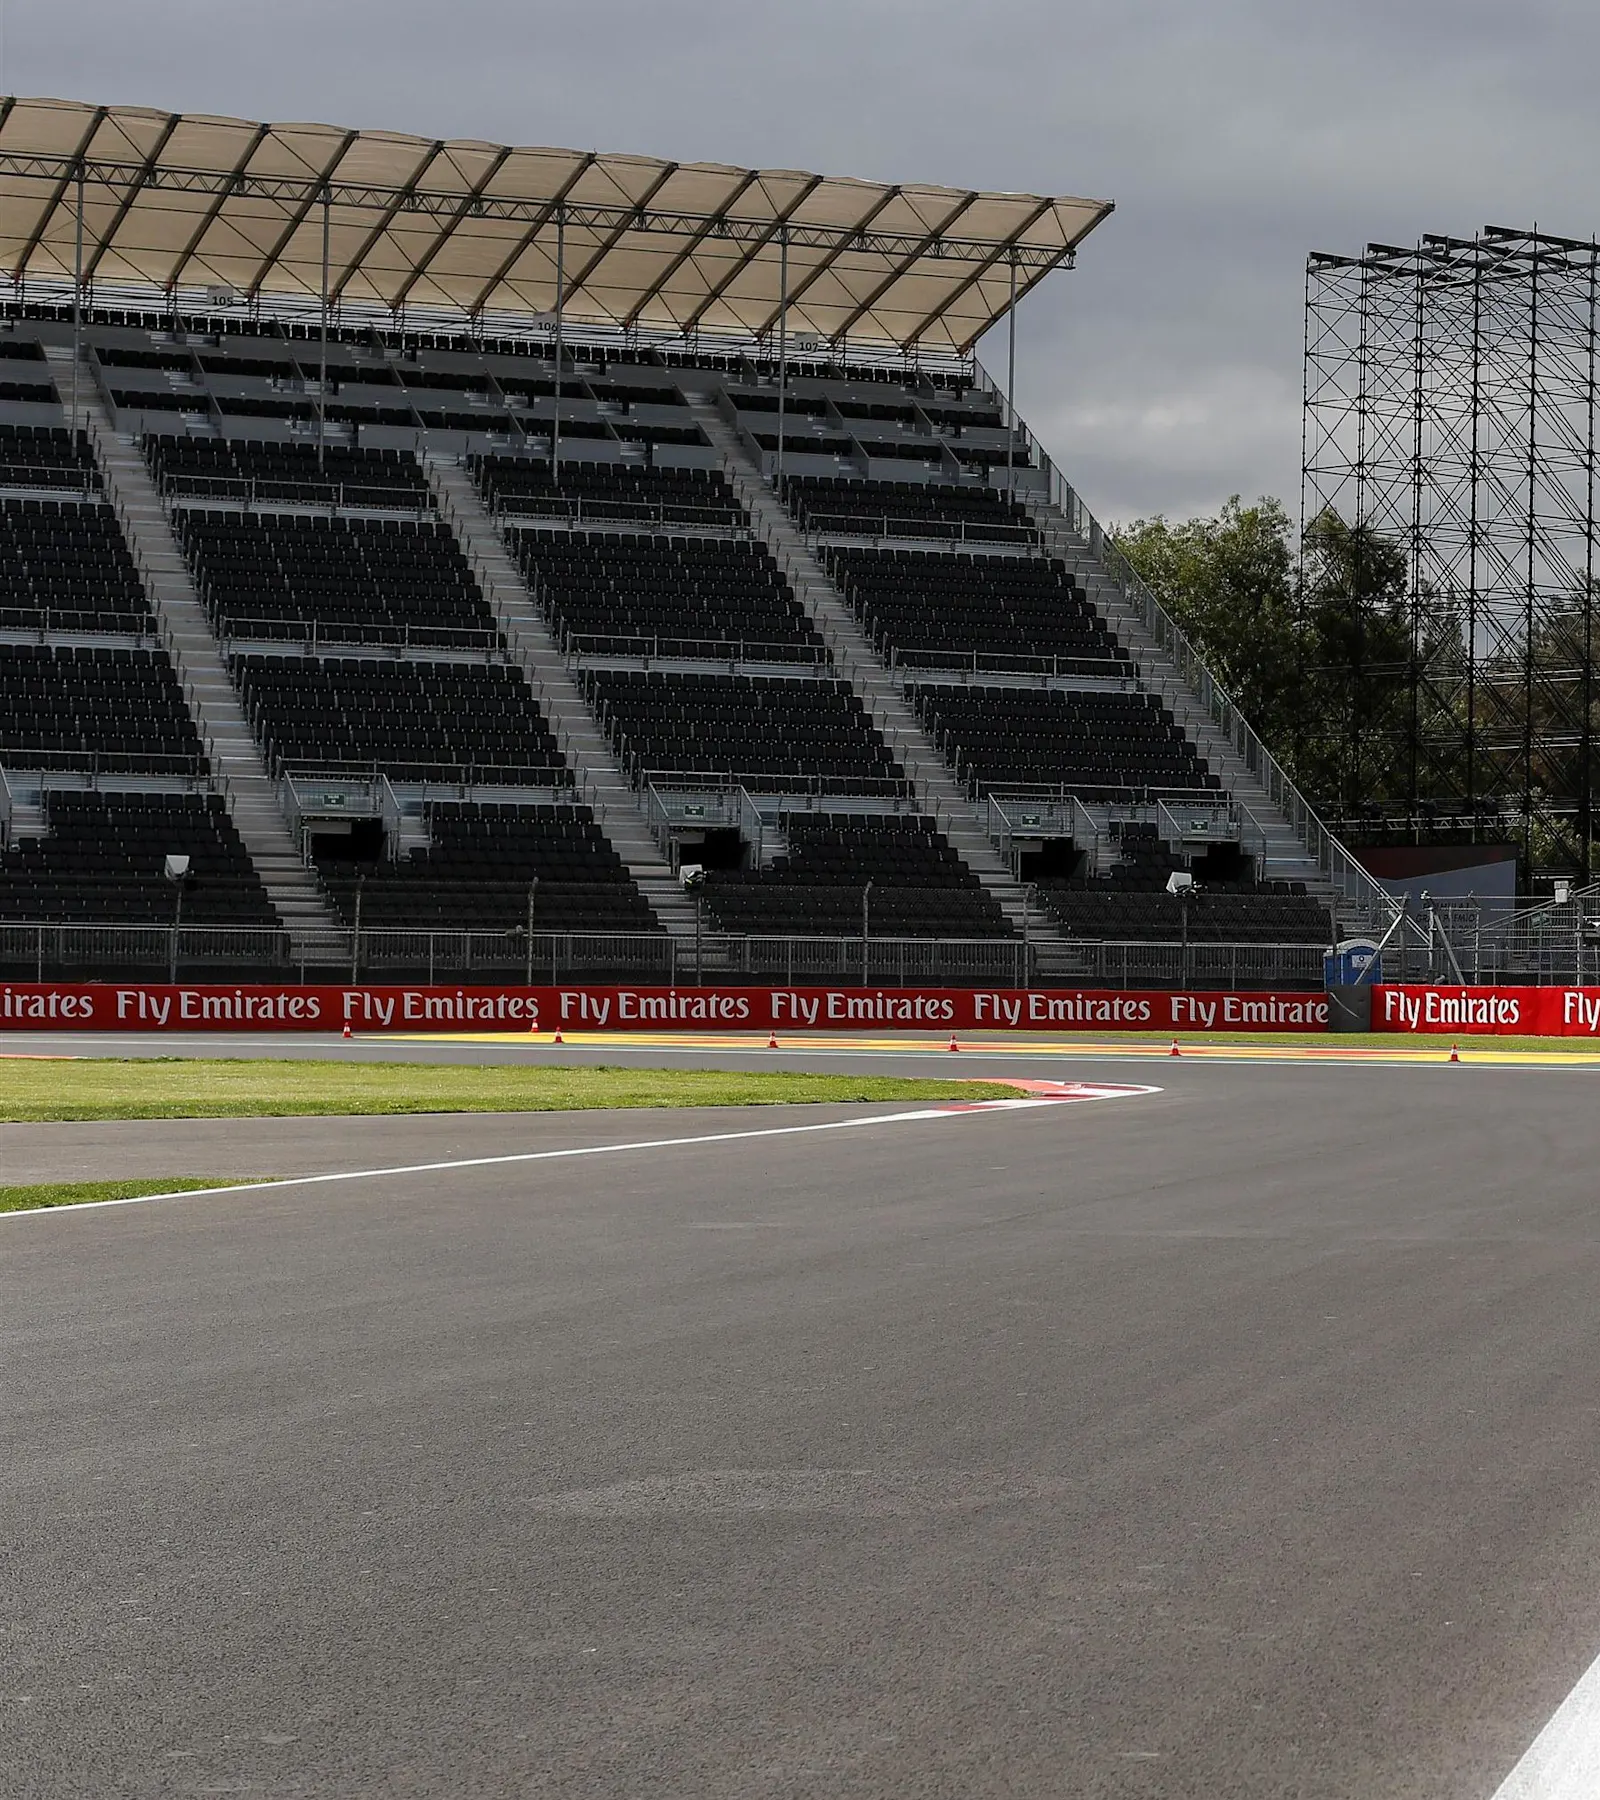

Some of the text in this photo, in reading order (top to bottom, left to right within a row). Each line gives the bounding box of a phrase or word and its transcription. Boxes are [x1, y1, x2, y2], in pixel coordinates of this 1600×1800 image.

[538, 322, 557, 331] 106
[800, 342, 818, 351] 107
[0, 988, 94, 1019] irates
[117, 990, 320, 1026] Fly Emirates
[343, 991, 538, 1026] Fly Emirates
[560, 991, 750, 1025] Fly Emirates
[771, 992, 953, 1026] Fly Emirates
[974, 992, 1150, 1026] Fly Emirates
[1171, 993, 1328, 1027] Fly Emirate
[1385, 991, 1520, 1028] Fly Emirates
[1564, 992, 1600, 1031] Fly
